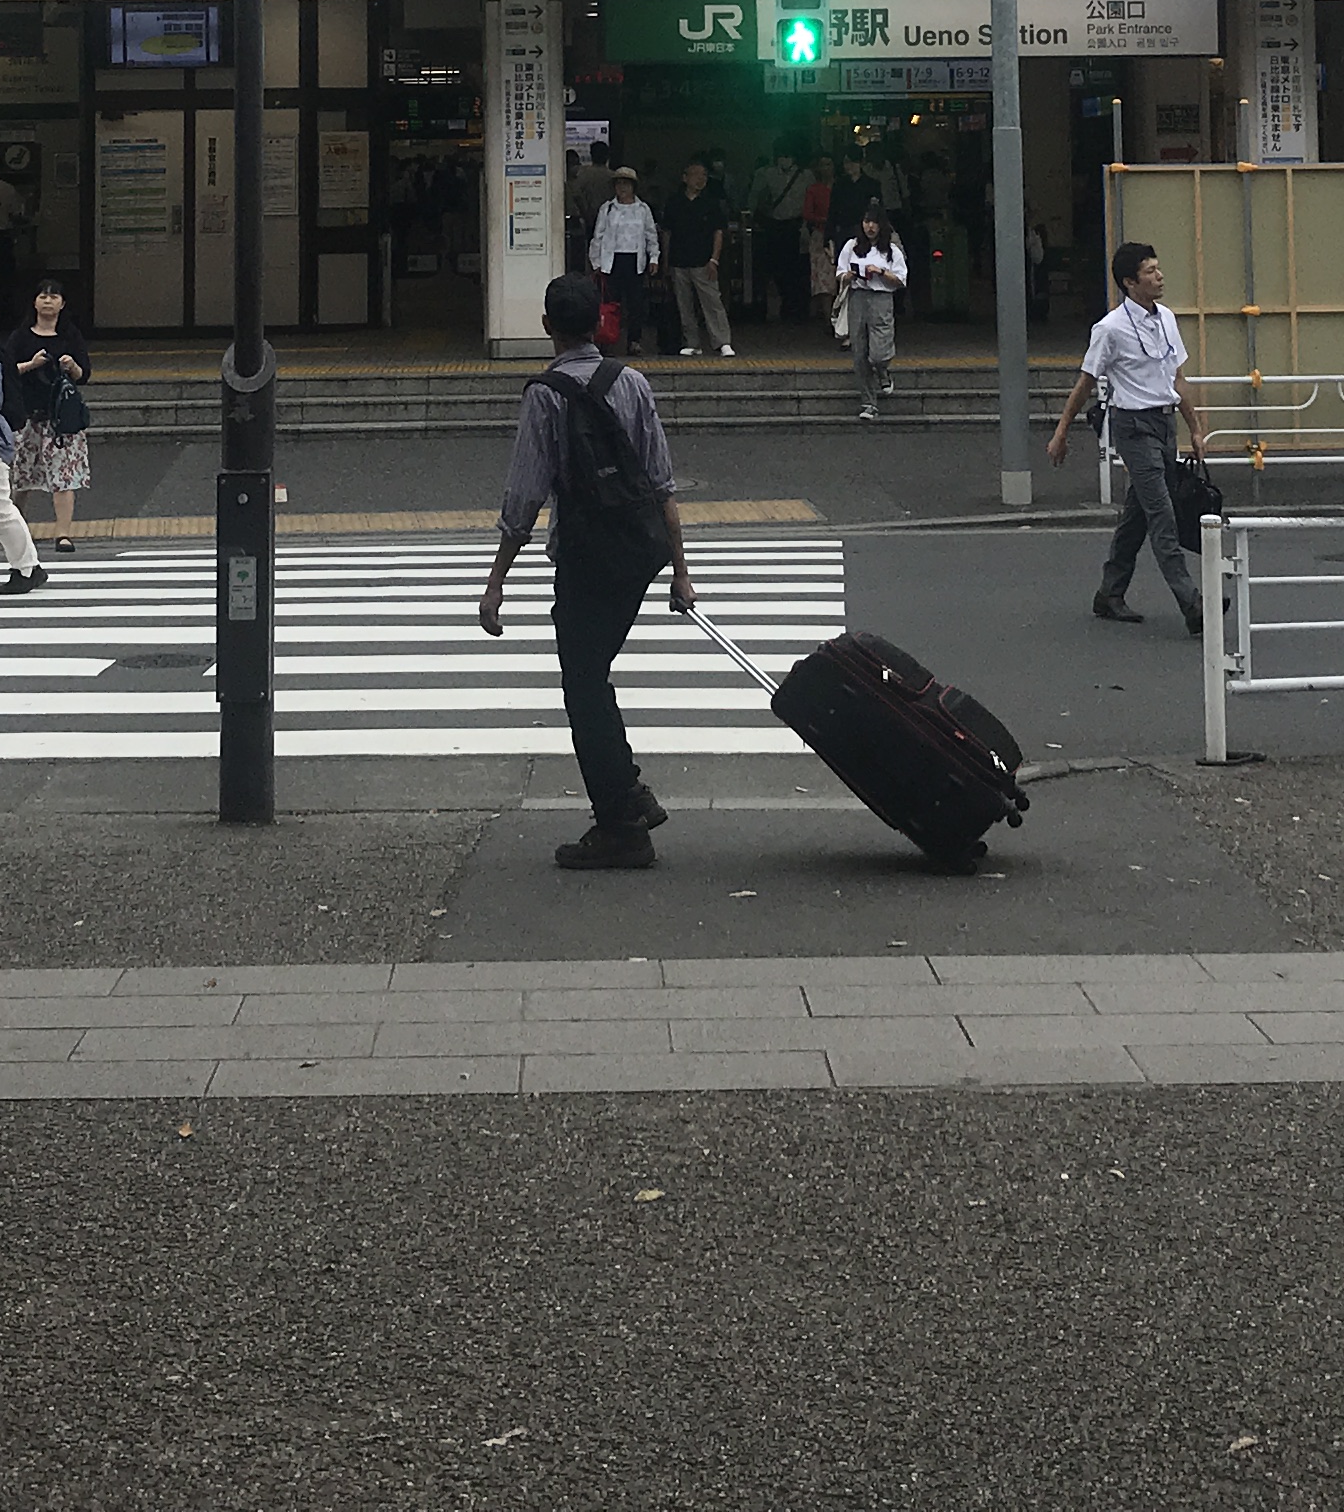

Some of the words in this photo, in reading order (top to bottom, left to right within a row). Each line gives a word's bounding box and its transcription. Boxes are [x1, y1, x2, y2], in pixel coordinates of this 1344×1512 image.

[1086, 0, 1145, 20] 公園口
[679, 4, 743, 40] JR
[1086, 23, 1115, 34] Park
[1118, 23, 1172, 34] Entrance
[904, 25, 970, 46] Ueno
[978, 23, 1068, 46] Stion
[687, 42, 735, 53] JR東日本
